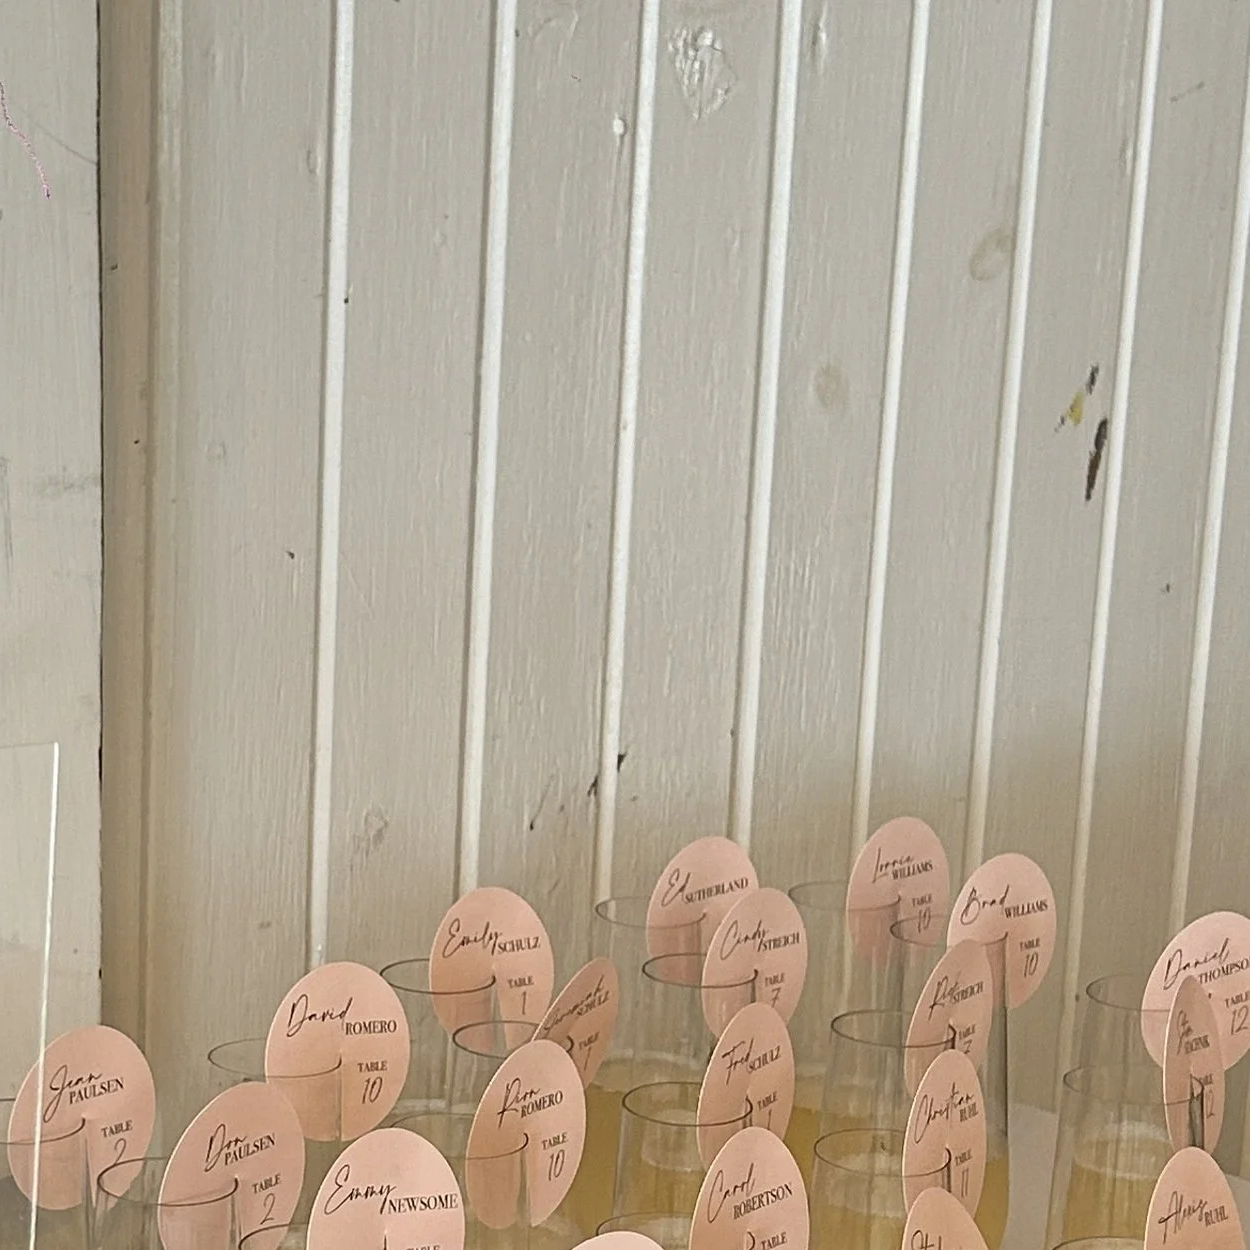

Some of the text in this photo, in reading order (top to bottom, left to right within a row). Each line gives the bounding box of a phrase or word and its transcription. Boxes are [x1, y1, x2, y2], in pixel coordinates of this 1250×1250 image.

[661, 867, 749, 907] Ed SUTHERLAND
[917, 906, 932, 934] 10
[960, 885, 1049, 926] Brad WILLIAMS
[442, 917, 541, 959] Emily SCHULZ
[719, 919, 770, 961] Cindy
[1019, 938, 1041, 951] TABLE
[1023, 951, 1040, 979] 10
[1163, 937, 1250, 991] Daniel THOMPSO
[507, 975, 535, 988] TABLE
[286, 993, 398, 1038] David ROMERO
[1231, 1005, 1249, 1036] 12
[357, 1060, 388, 1073] TABLE
[721, 1037, 755, 1086] Fred
[43, 1064, 125, 1124] Jean PAULSEN
[361, 1075, 384, 1105] 10
[520, 1089, 564, 1119] ROMERO
[101, 1119, 134, 1139] TABLE
[541, 1131, 569, 1151] TABLE
[113, 1137, 127, 1167] 2
[224, 1132, 276, 1166] PAULSEN
[548, 1149, 566, 1182] 10
[252, 1173, 282, 1195] TABLE
[323, 1164, 460, 1216] Emmy NEWSOME
[708, 1162, 794, 1224] Carol ROBERTSON
[260, 1192, 276, 1225] 2
